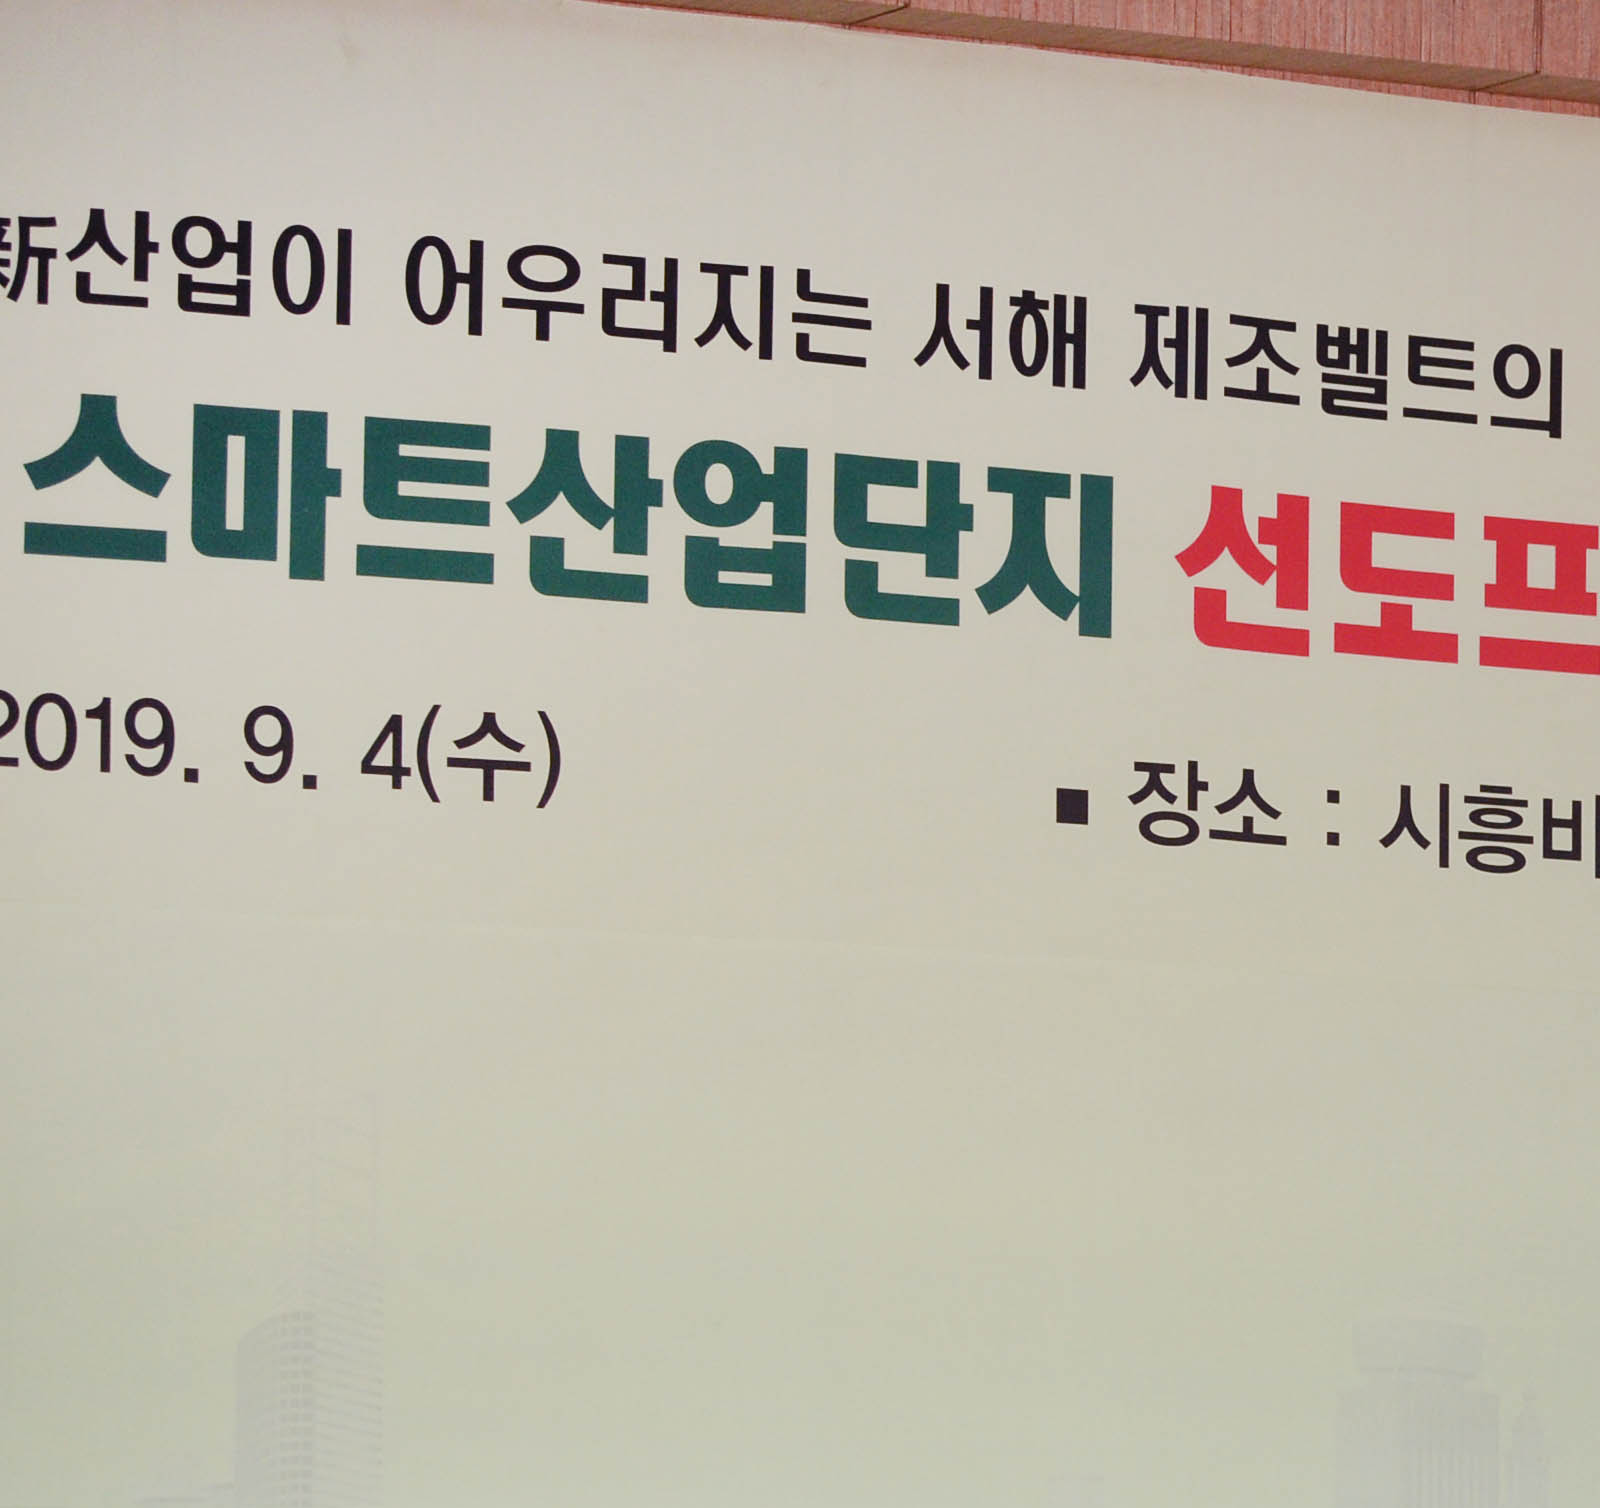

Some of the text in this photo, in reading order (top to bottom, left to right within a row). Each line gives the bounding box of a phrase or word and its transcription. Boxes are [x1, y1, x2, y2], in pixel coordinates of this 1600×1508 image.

[405, 235, 873, 368] 어우러지는
[913, 282, 1089, 390] 서해
[1129, 303, 1563, 440] 제조벨트의
[22, 392, 1114, 639] 스마트산업단지
[243, 705, 318, 790] 9.
[360, 704, 561, 809] 4(수)
[1127, 759, 1288, 847] 장소
